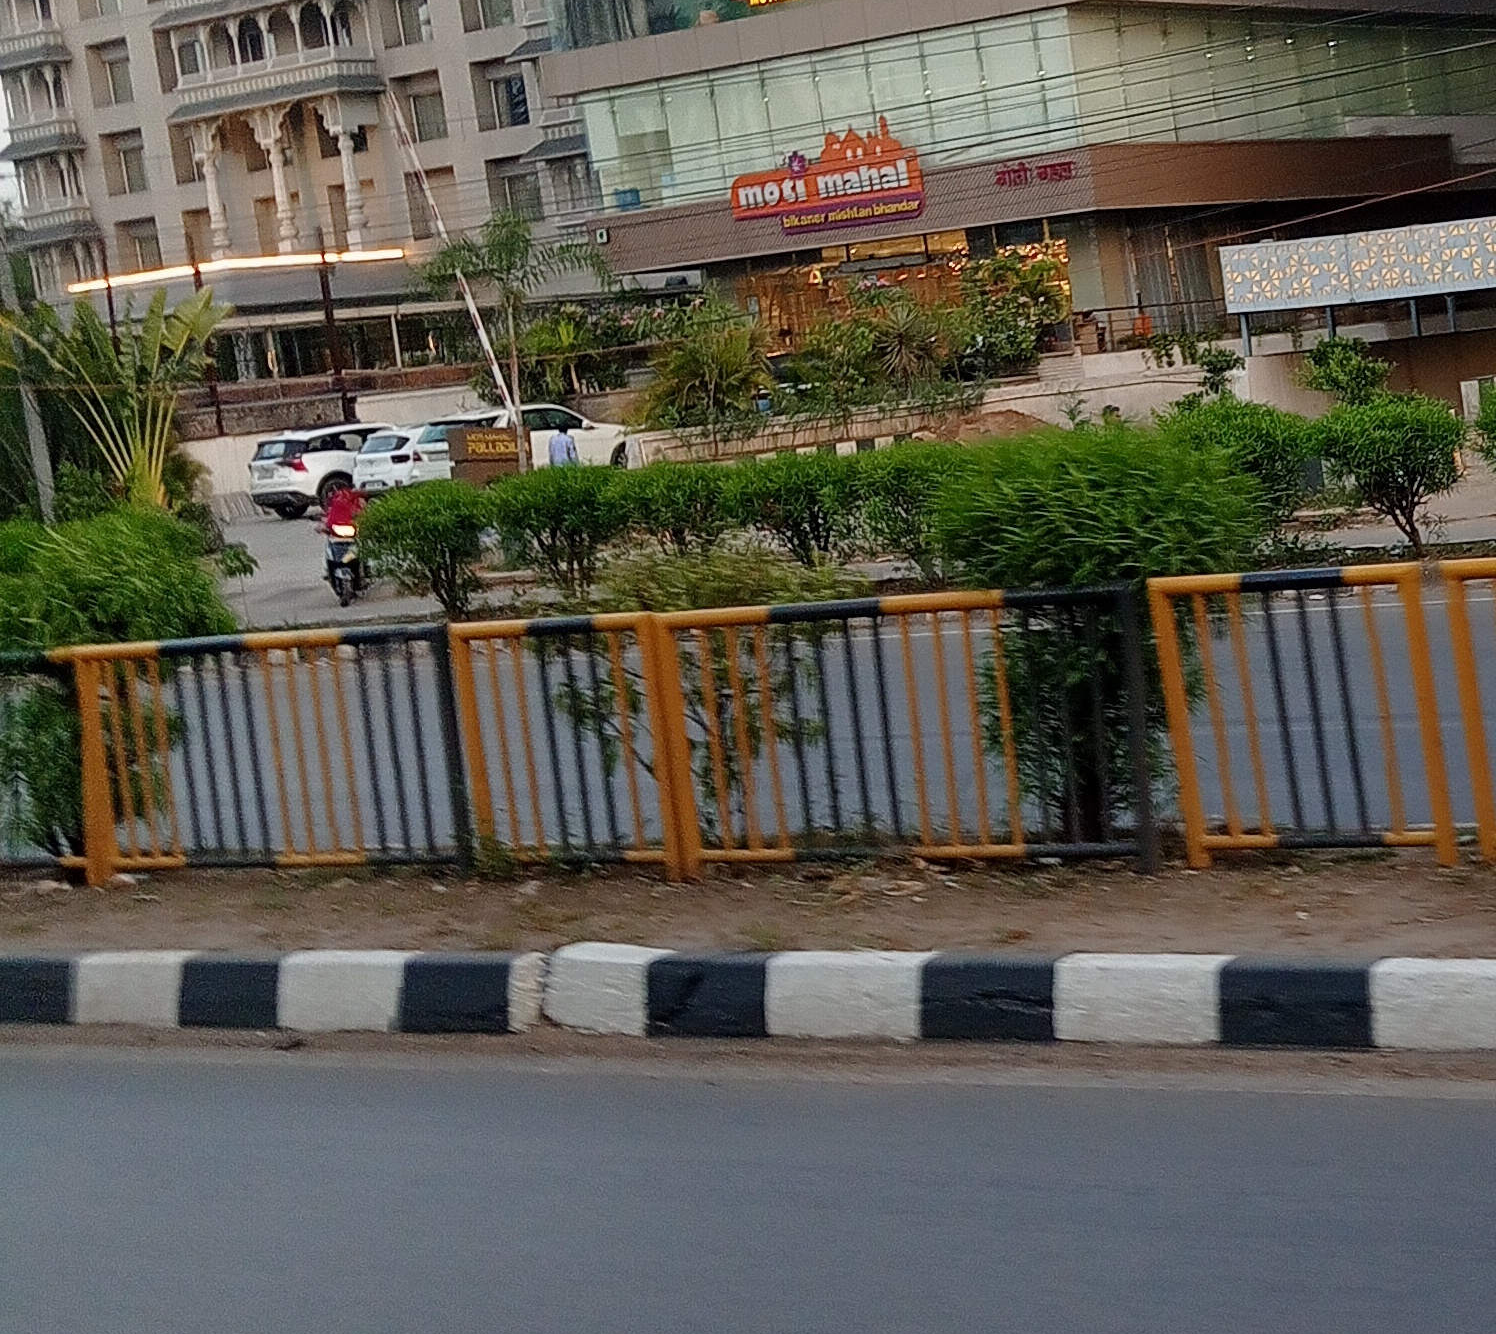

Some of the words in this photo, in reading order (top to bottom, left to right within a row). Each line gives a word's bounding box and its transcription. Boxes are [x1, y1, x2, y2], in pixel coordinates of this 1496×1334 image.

[738, 175, 808, 210] moti
[816, 159, 910, 199] mahal
[828, 206, 873, 223] mishtan
[873, 199, 920, 216] bhandar
